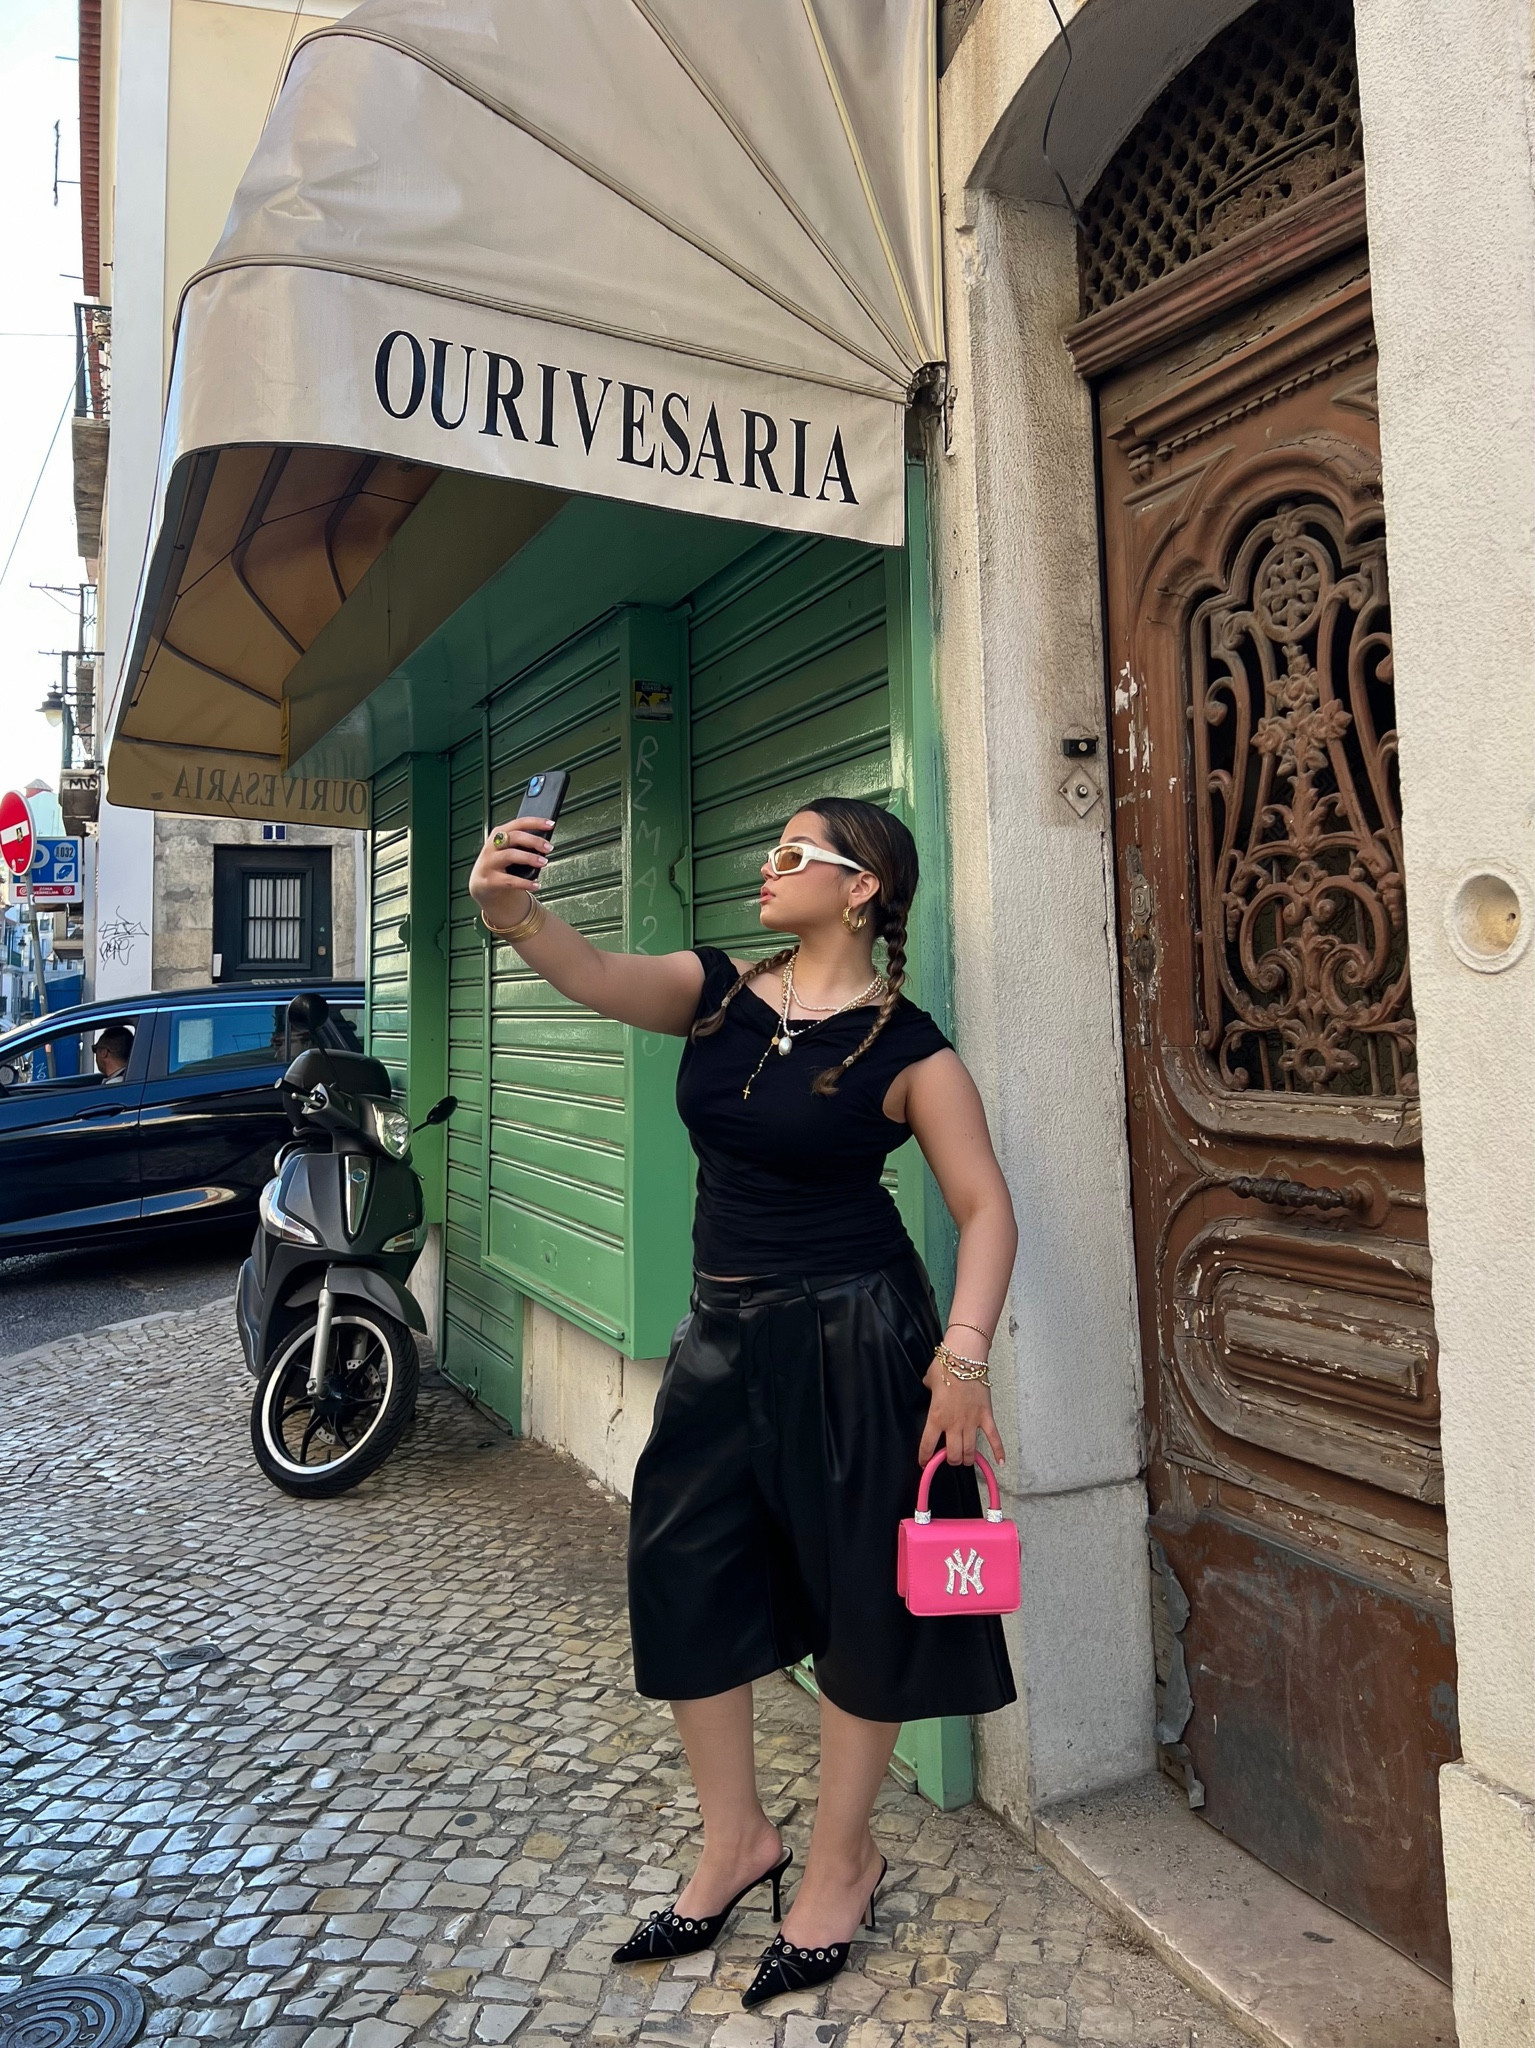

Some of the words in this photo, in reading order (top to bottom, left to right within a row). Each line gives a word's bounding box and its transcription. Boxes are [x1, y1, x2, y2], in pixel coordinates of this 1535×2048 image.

[374, 329, 860, 505] OURIVESARIA
[271, 825, 277, 840] 1
[60, 846, 74, 858] 032
[944, 1547, 985, 1595] NY
